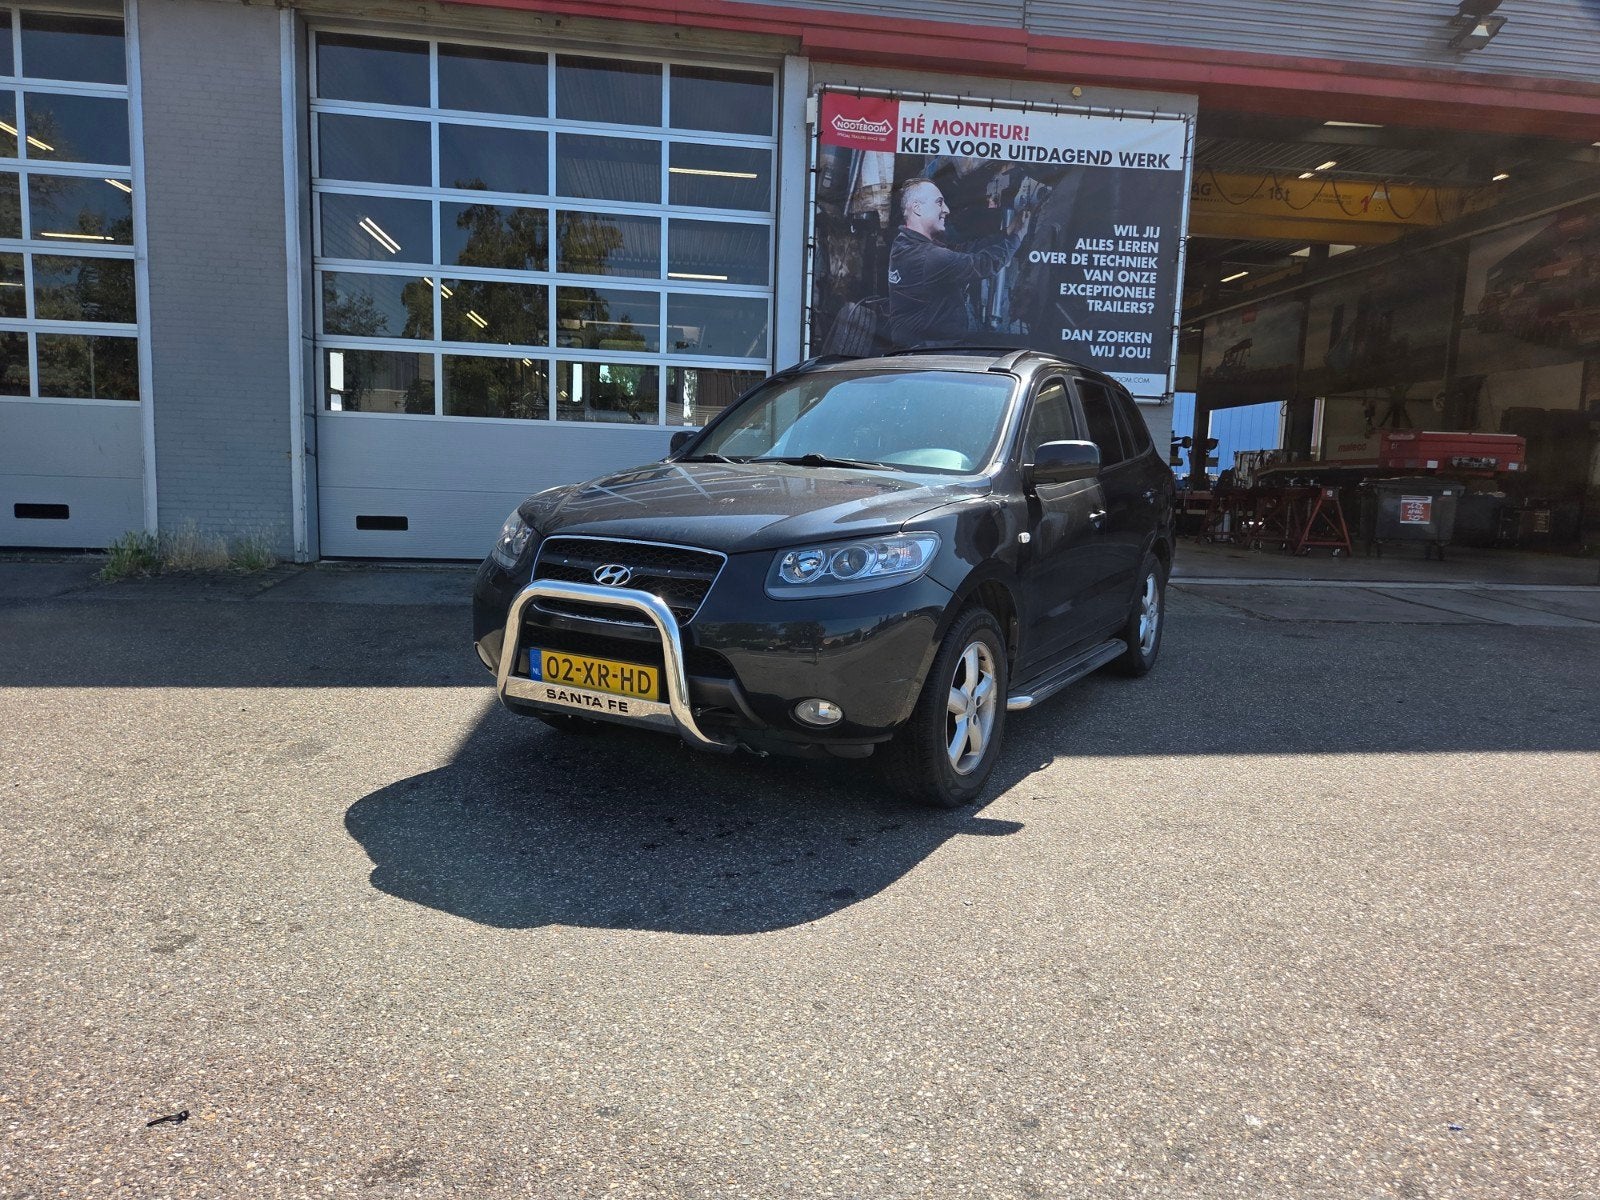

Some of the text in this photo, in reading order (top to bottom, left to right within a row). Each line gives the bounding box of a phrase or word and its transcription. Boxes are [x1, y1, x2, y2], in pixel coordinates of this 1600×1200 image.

[837, 121, 887, 132] NOOTEBOOM
[901, 114, 1030, 142] HÉ MONTEUR!
[901, 137, 1171, 169] KIES VOOR UITDAGEND WERK
[1113, 224, 1161, 238] WIL JIJ
[1075, 238, 1159, 254] ALLES LEREN
[1029, 251, 1158, 269] OVER DE TECHNIEK
[1083, 269, 1157, 284] VAN ONZE
[1060, 283, 1156, 299] EXCEPTIONELE
[1087, 299, 1155, 314] TRAILERS?
[1061, 328, 1153, 344] DAN ZOEKEN
[1089, 344, 1151, 359] WIJ JOU!
[532, 655, 652, 695] NL 02-XR-HD
[546, 688, 629, 713] SANTA FE
